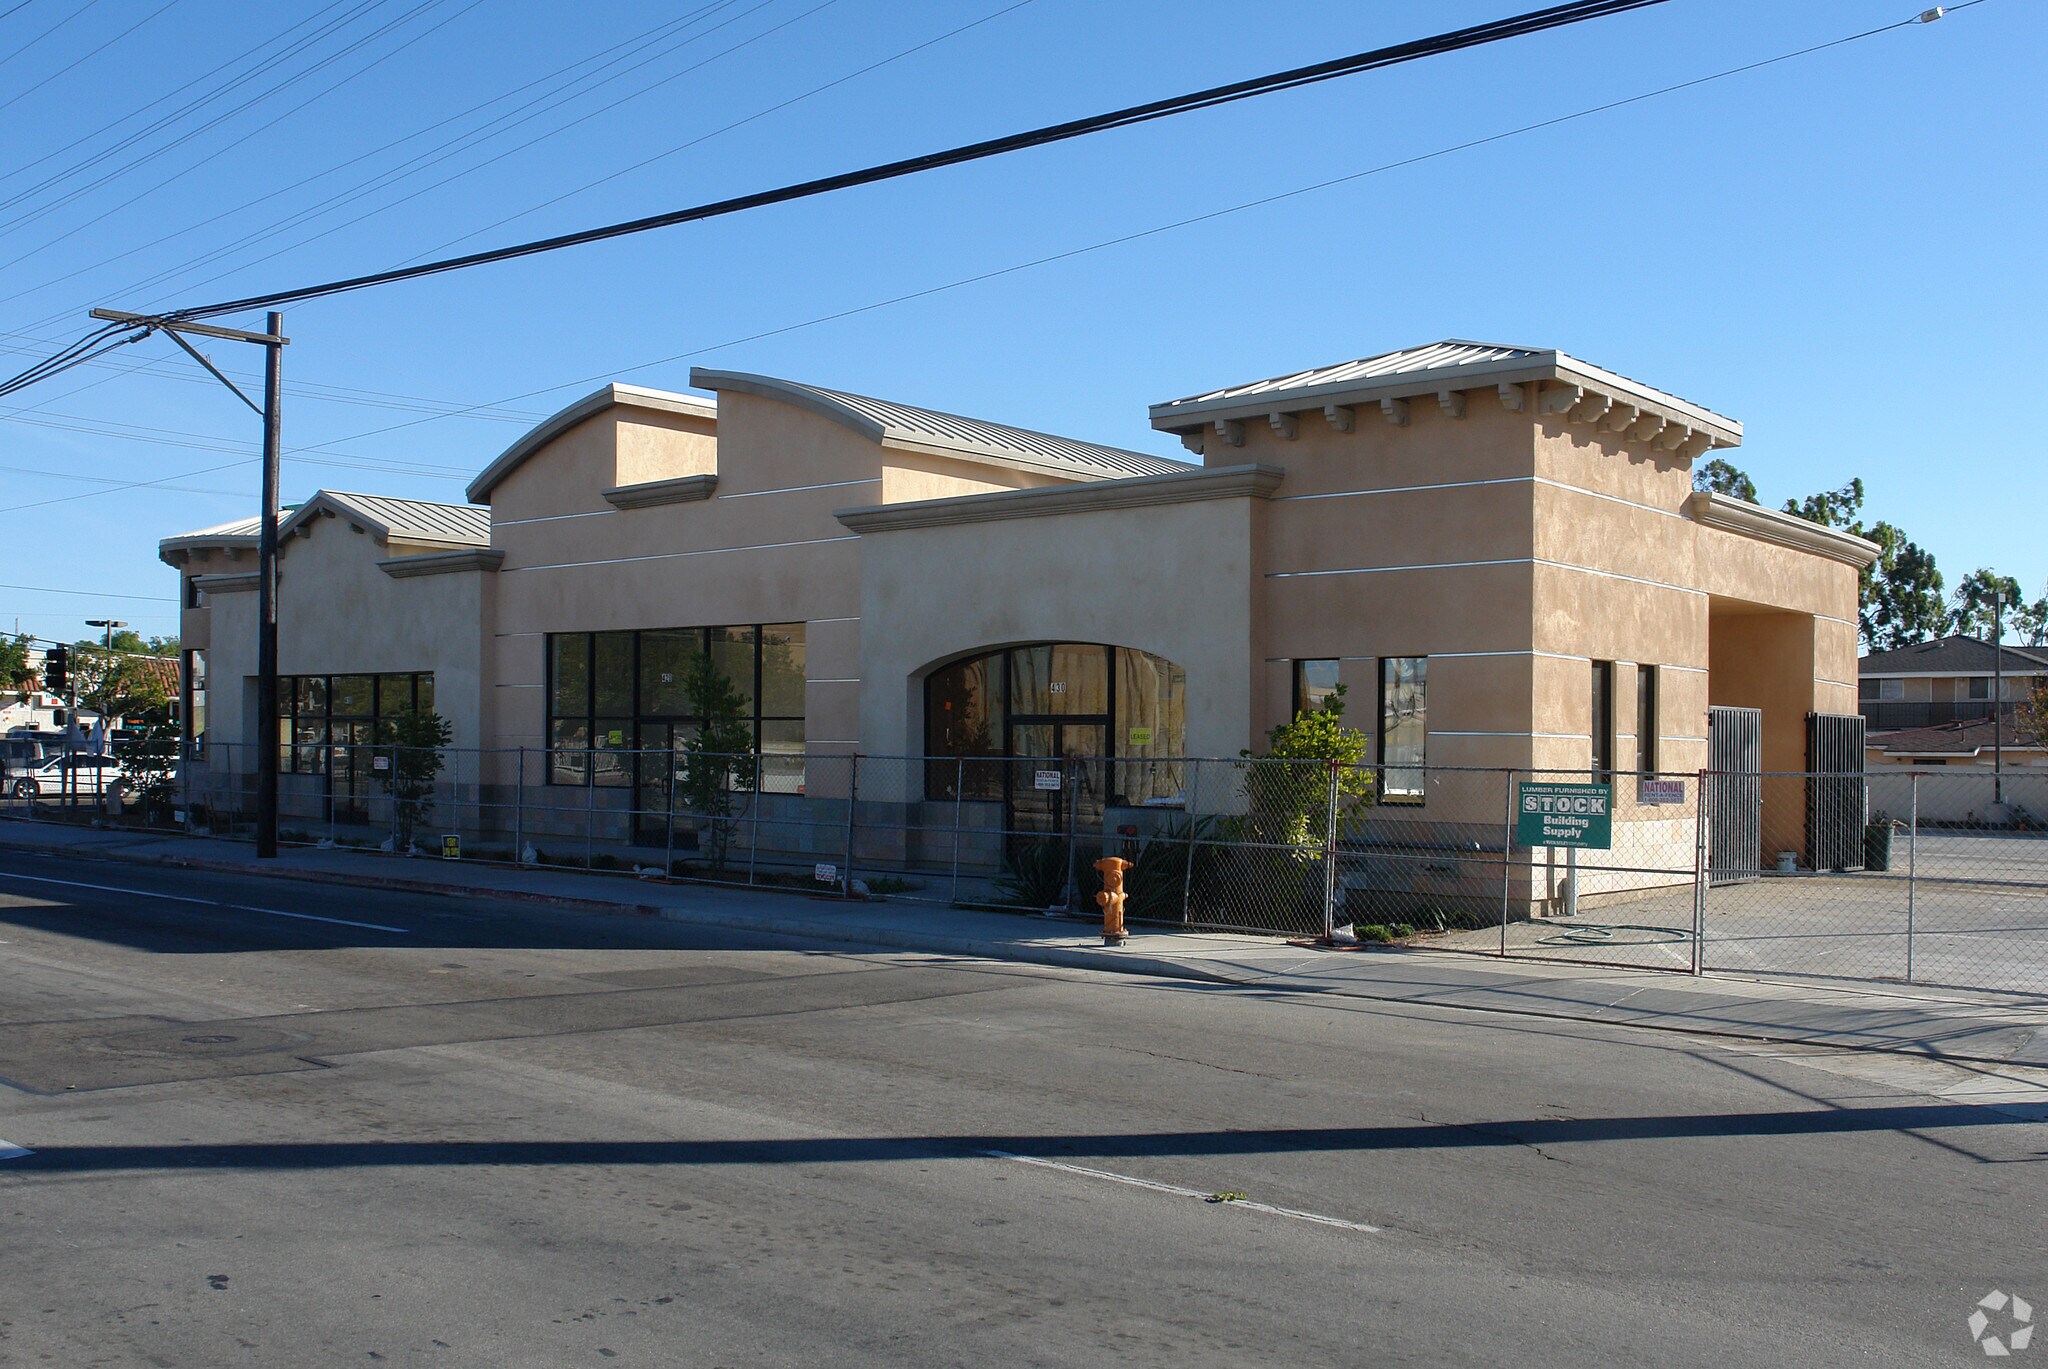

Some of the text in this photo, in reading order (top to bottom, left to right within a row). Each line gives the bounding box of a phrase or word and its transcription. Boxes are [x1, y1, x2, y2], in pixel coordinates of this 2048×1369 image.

[1050, 682, 1067, 693] 430
[1644, 781, 1683, 793] NATIONAL
[1524, 795, 1605, 814] STOCK
[1543, 815, 1589, 828] Building
[1542, 826, 1582, 839] Supply
